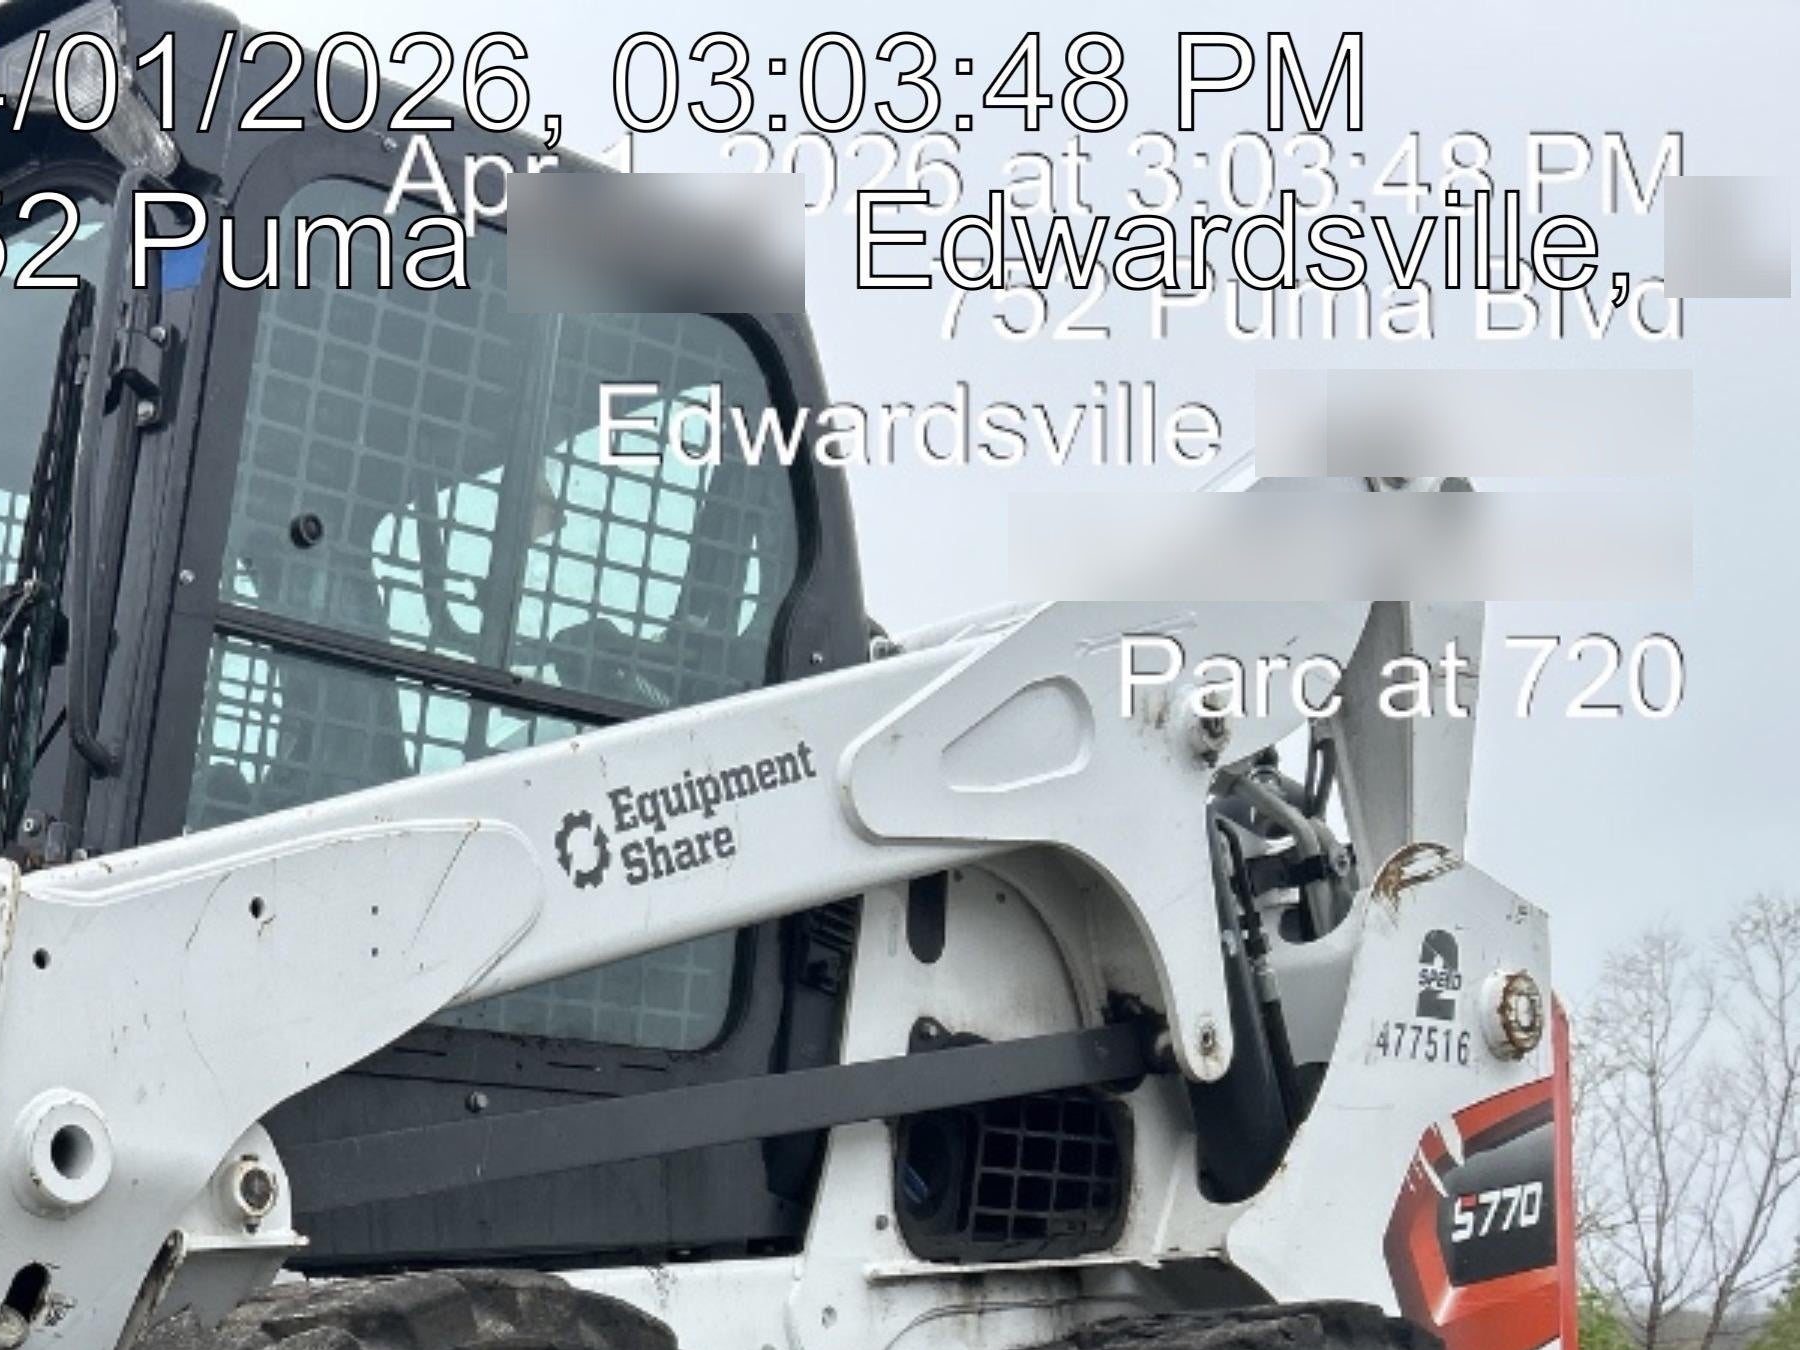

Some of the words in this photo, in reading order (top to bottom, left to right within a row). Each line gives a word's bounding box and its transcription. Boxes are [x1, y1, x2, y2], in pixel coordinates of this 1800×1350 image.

[606, 739, 817, 833] Equipment
[620, 825, 736, 886] Share
[1376, 1023, 1470, 1066] 477516
[1451, 1180, 1543, 1243] S770
